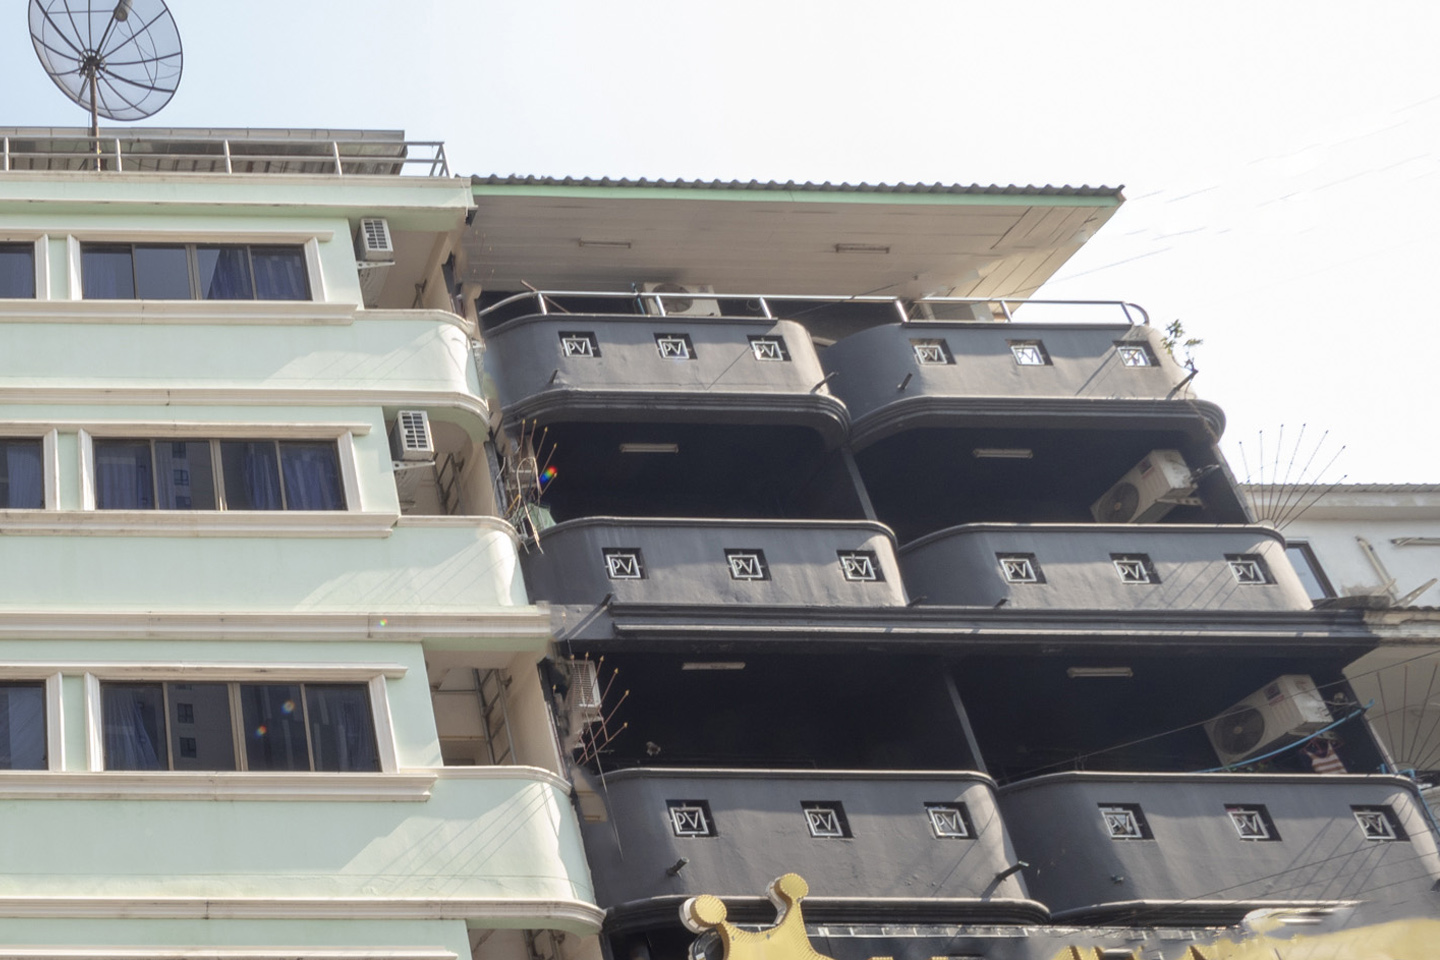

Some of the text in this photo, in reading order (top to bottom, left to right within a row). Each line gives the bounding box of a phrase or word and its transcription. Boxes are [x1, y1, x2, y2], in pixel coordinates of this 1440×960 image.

[611, 558, 633, 574] PV
[732, 558, 754, 574] PV
[675, 811, 700, 830] PV
[810, 812, 833, 831] PV
